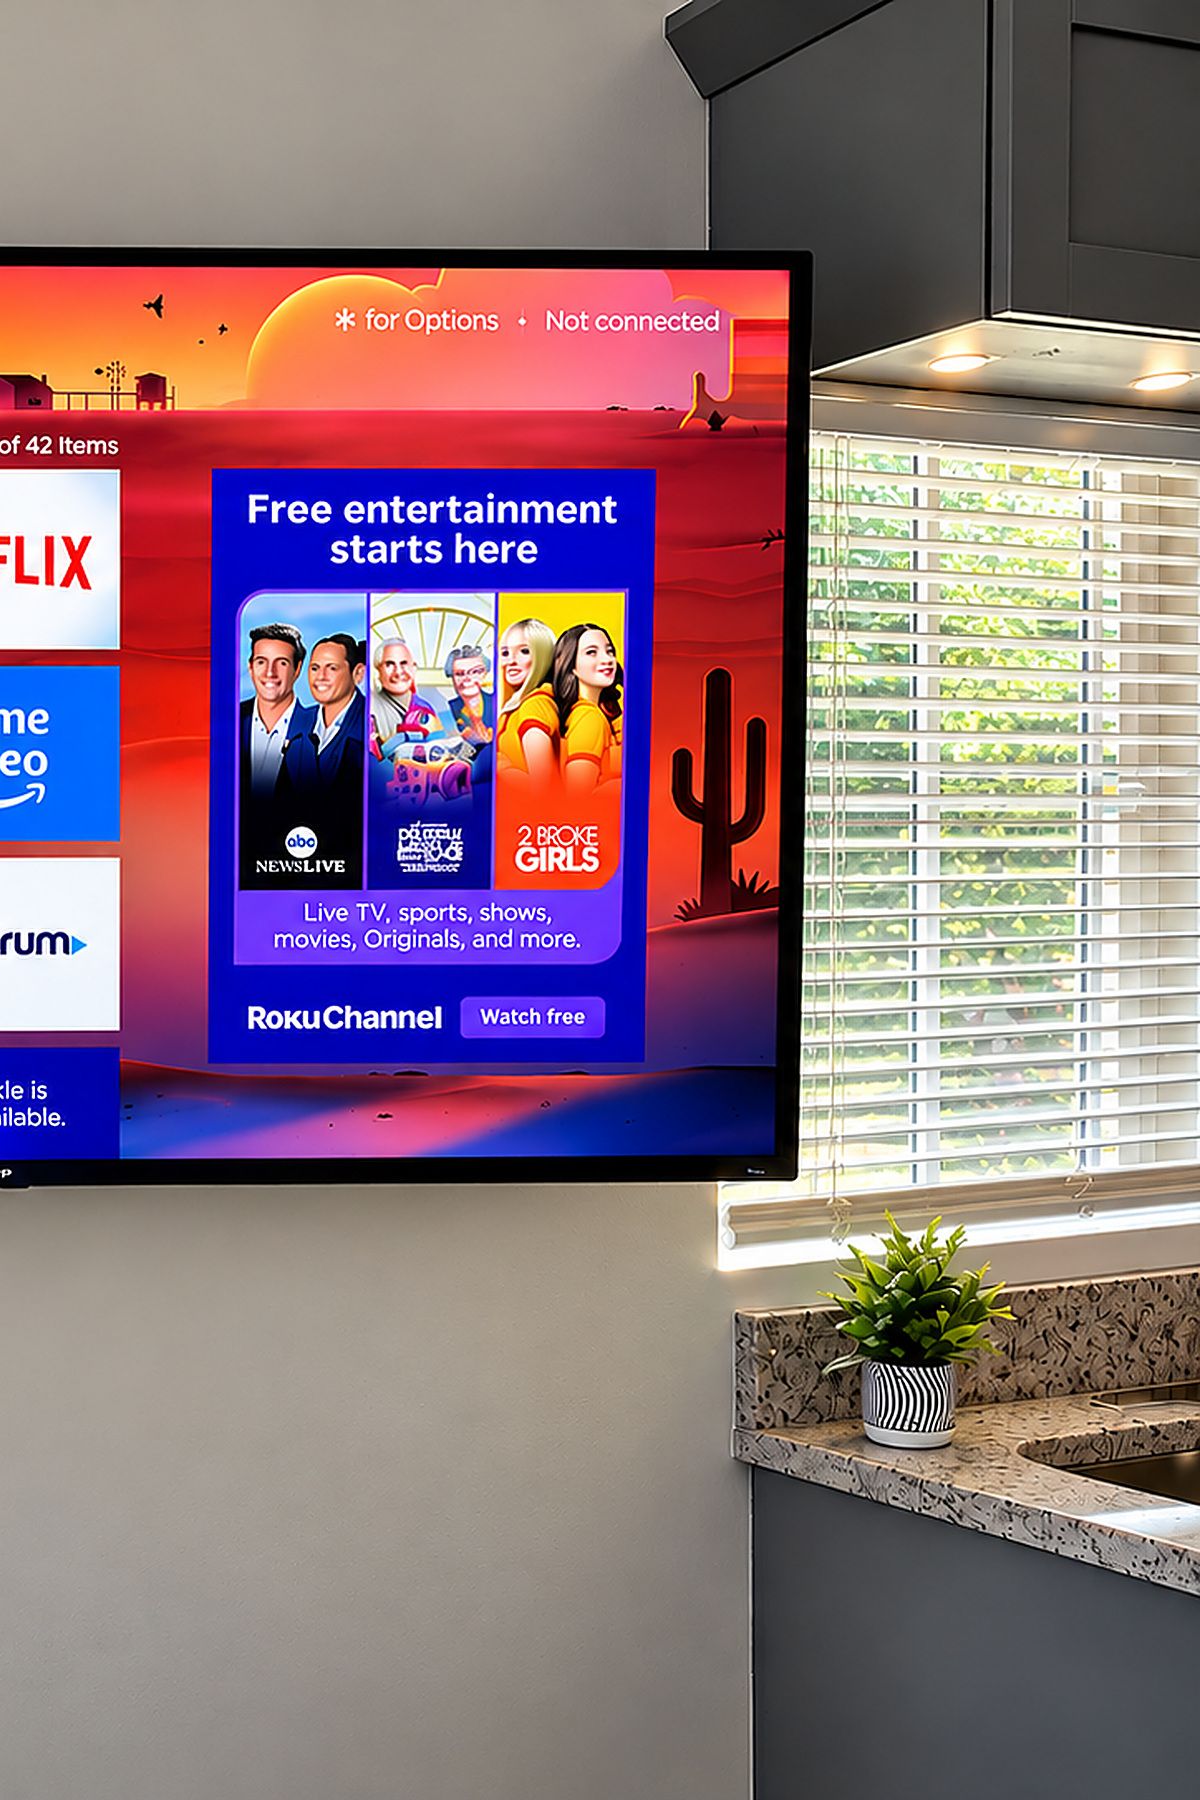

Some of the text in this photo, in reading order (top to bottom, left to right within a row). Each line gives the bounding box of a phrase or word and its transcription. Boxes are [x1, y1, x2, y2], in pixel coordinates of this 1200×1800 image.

[365, 308, 499, 335] for Options
[545, 309, 720, 333] Not connected
[25, 436, 53, 455] 42
[58, 436, 119, 455] Items
[247, 493, 618, 525] Free entertainment
[329, 533, 539, 564] starts here
[518, 825, 599, 847] 2 BROKE
[514, 846, 600, 873] GIRLS
[303, 903, 553, 928] Live TV, sports, shows,
[273, 929, 582, 953] movies, Originals, and more.
[480, 1007, 586, 1026] Watch free
[30, 1080, 47, 1100] is
